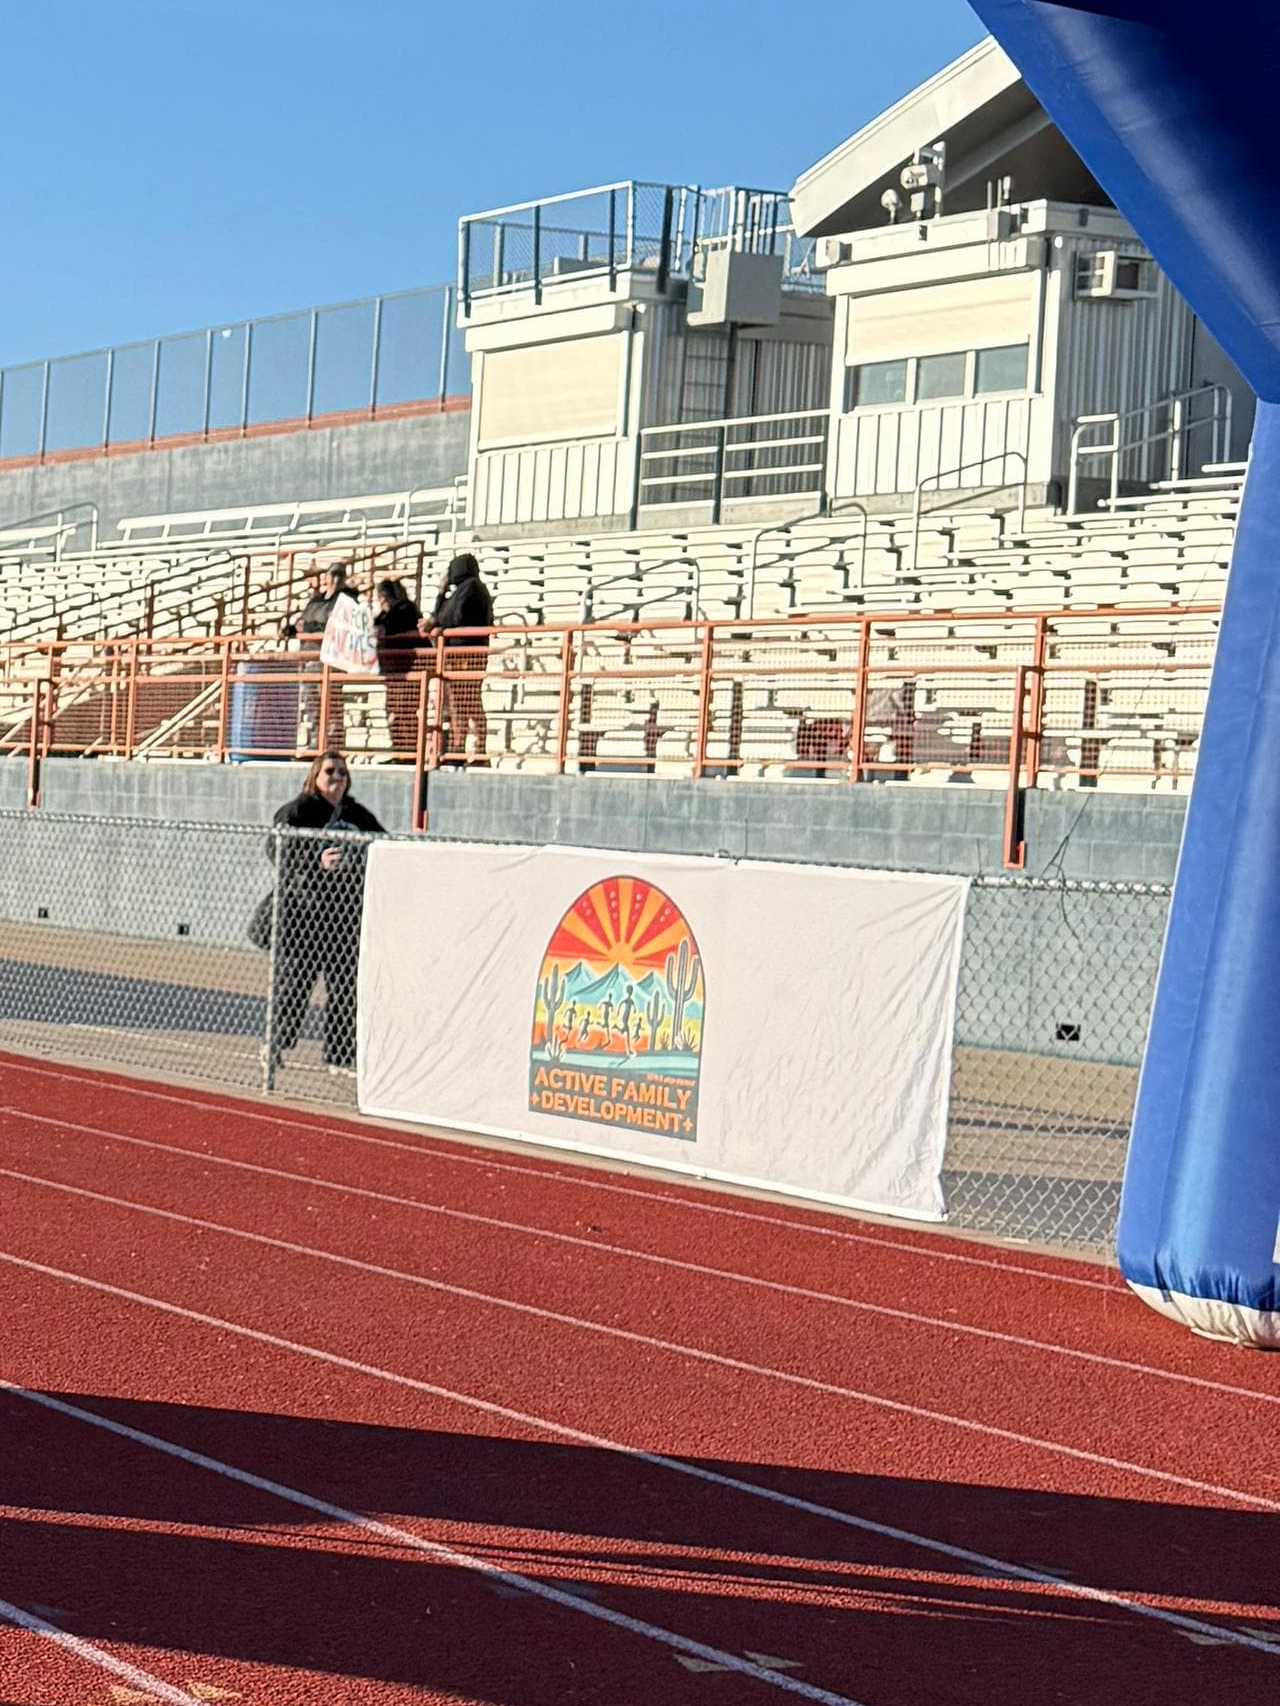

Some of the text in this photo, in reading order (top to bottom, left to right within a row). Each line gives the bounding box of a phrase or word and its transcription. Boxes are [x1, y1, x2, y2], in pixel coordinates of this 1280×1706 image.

[534, 1066, 692, 1111] ACTIVE FAMILY
[541, 1090, 683, 1134] DEVELOPMENT
